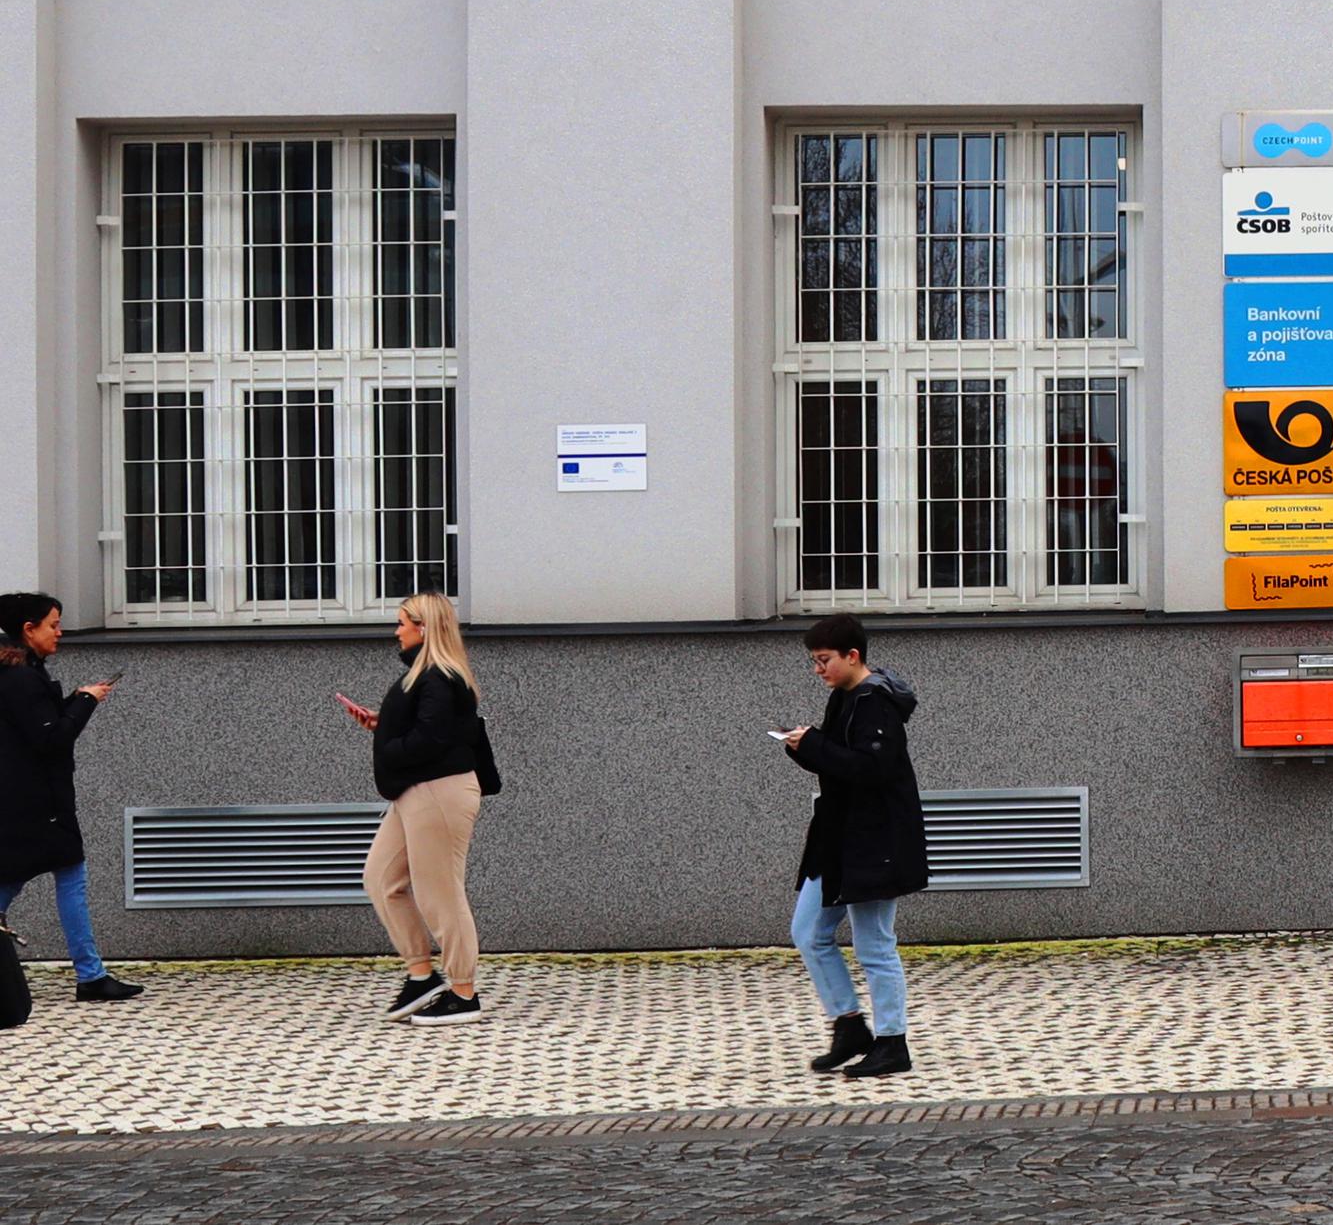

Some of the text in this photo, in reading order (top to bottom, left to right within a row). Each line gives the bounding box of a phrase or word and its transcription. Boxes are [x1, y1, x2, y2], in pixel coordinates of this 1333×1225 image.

[1236, 217, 1291, 234] ČSOB
[1247, 306, 1321, 321] Bankovní
[1247, 330, 1257, 342] a
[1247, 348, 1286, 362] zóna
[1233, 468, 1293, 486] ČESKÁ
[1265, 505, 1287, 513] POŠTA
[1263, 575, 1329, 589] FilaPoint
